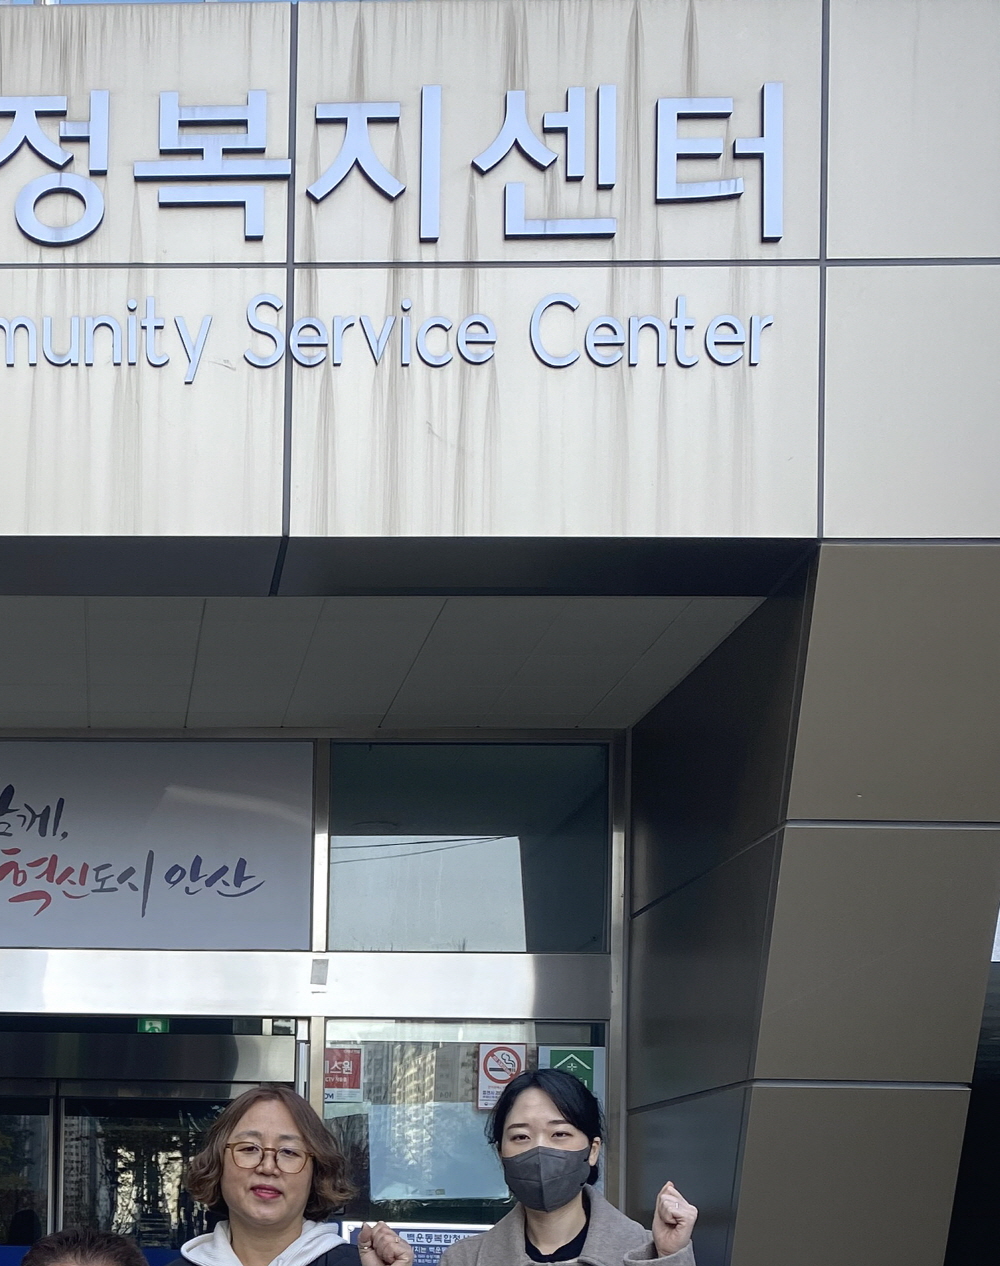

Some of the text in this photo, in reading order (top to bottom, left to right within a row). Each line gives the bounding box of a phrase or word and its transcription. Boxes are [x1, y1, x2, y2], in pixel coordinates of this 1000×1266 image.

[244, 292, 498, 368] Service
[529, 292, 774, 368] Center
[165, 855, 265, 897] 안산
